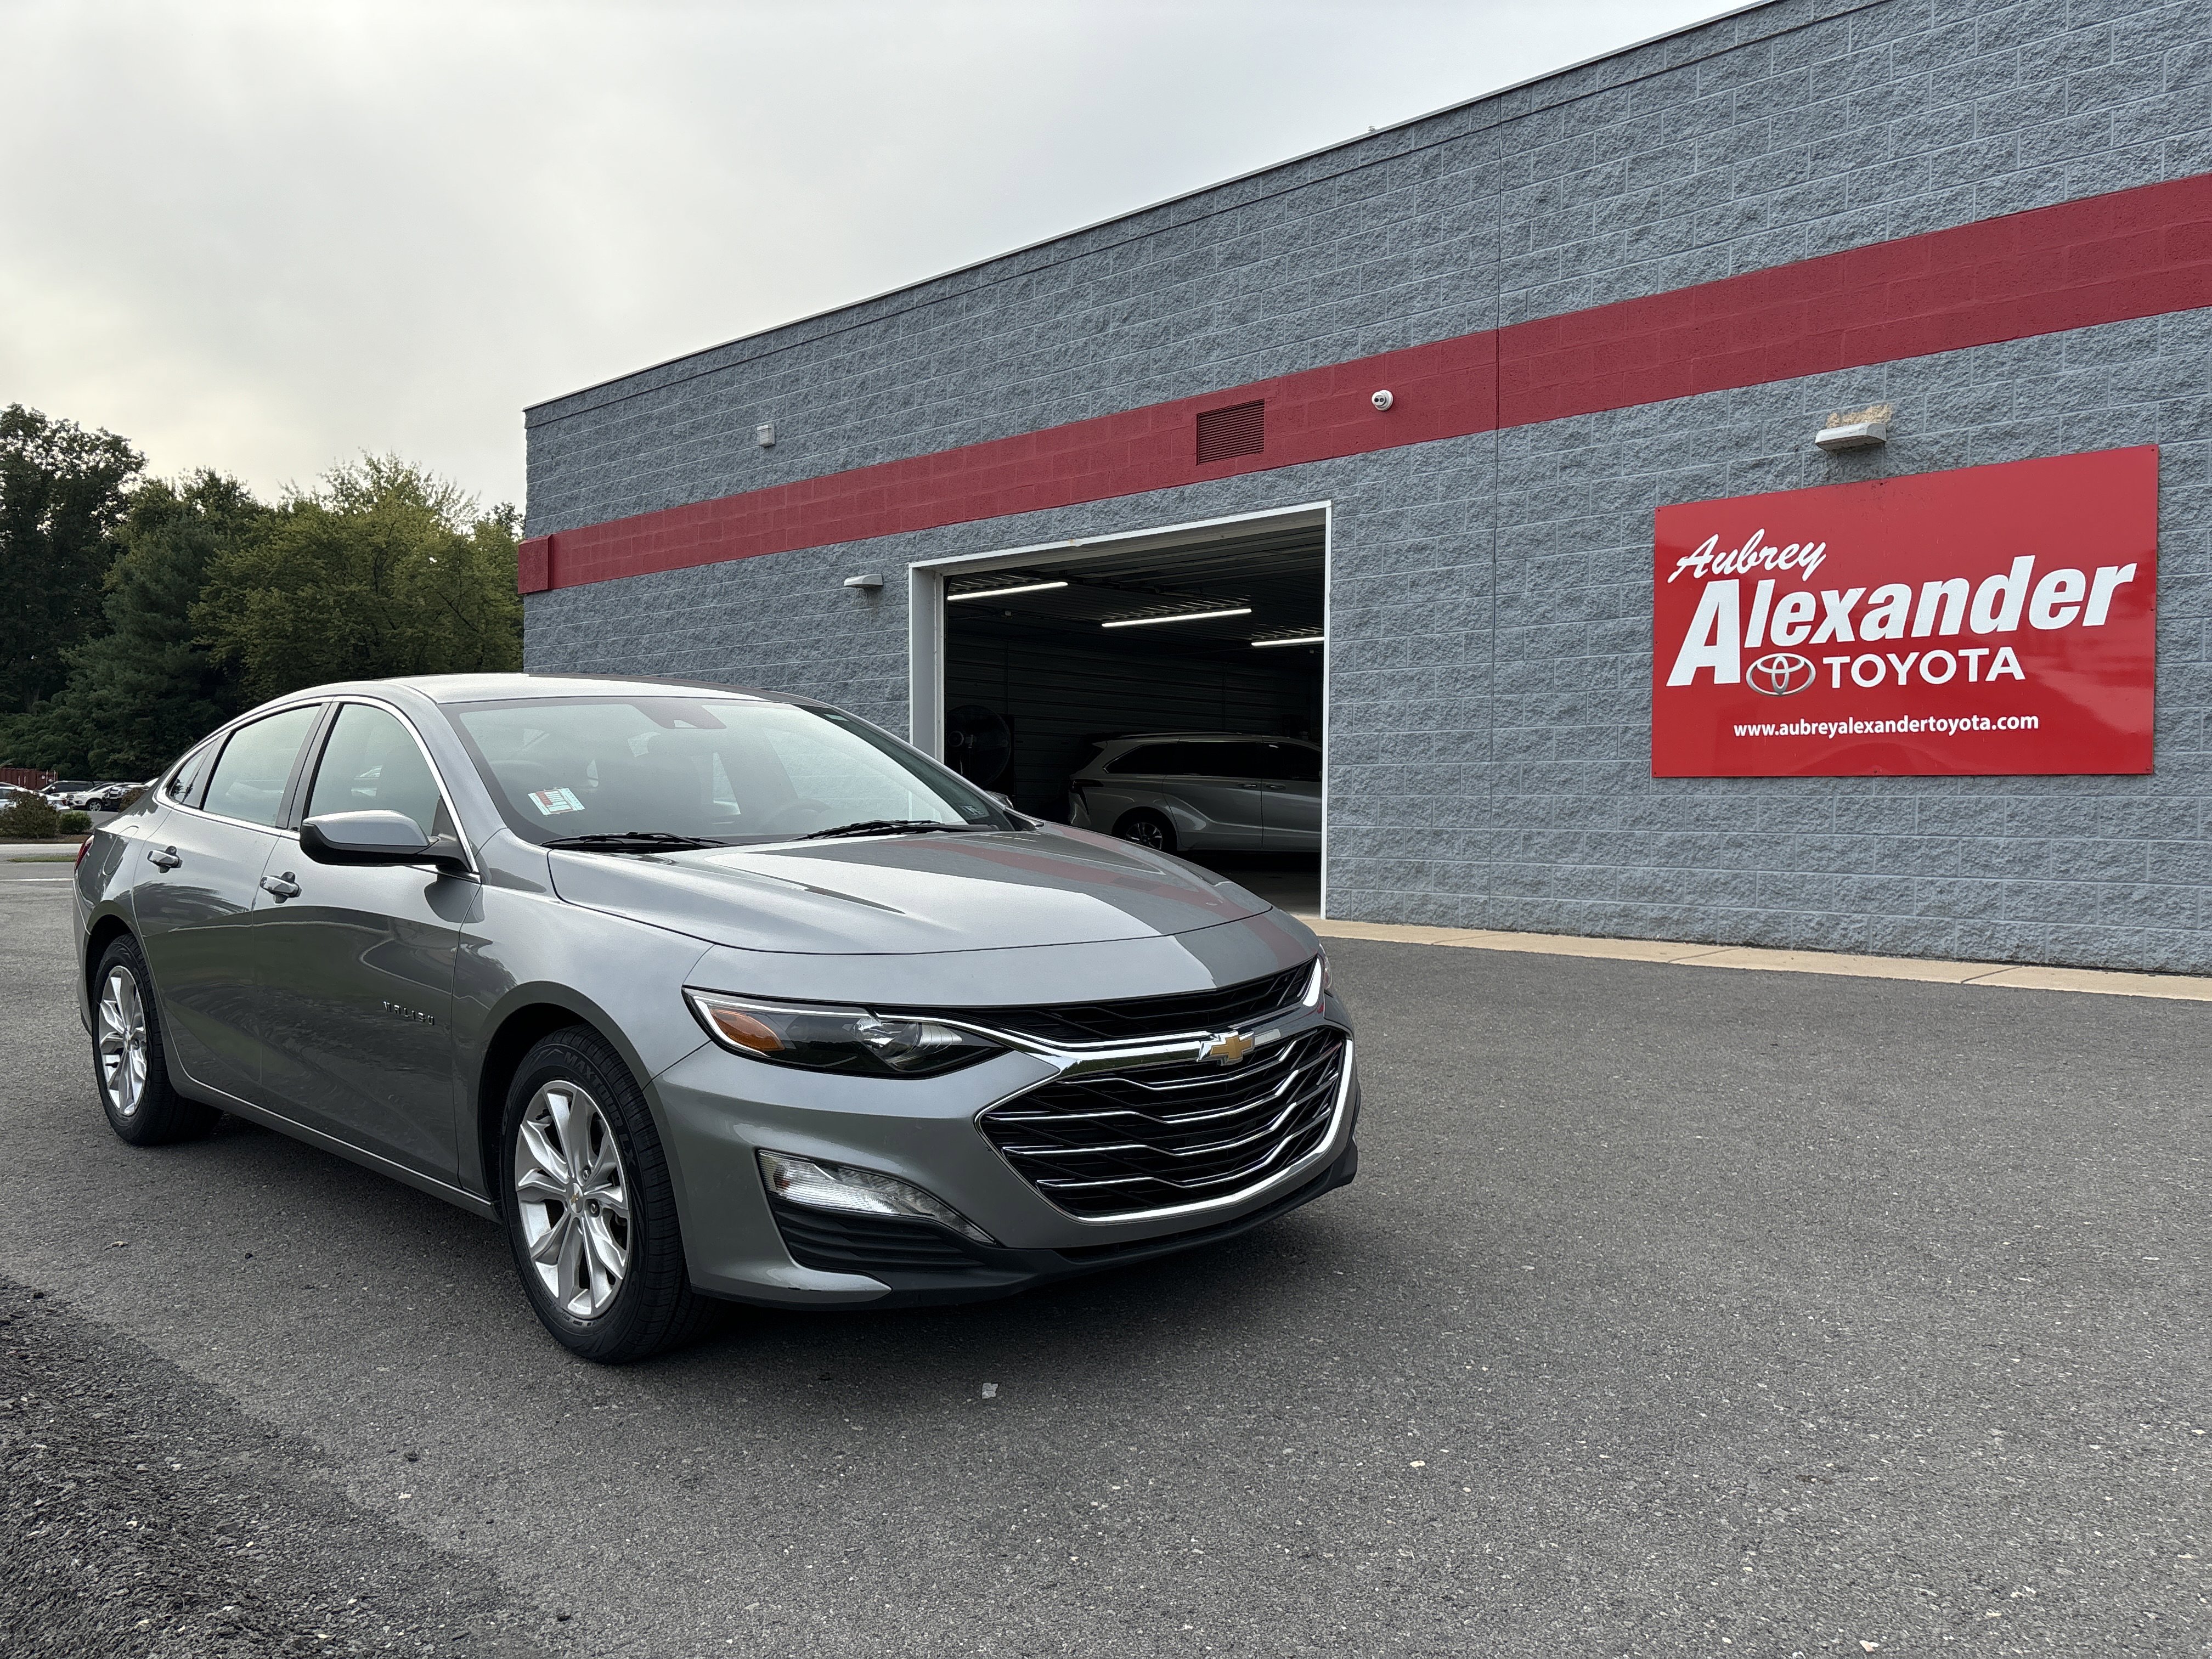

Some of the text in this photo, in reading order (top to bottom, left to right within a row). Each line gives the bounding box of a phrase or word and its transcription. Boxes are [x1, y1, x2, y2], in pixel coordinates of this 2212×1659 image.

[1668, 528, 1827, 583] Aubrey
[1666, 555, 2137, 687] Alexander
[1822, 646, 2026, 689] TOYOTA
[1733, 714, 2039, 739] www.aubreyalexandertoyota.com
[563, 1051, 636, 1167] MAXTOUR LX
